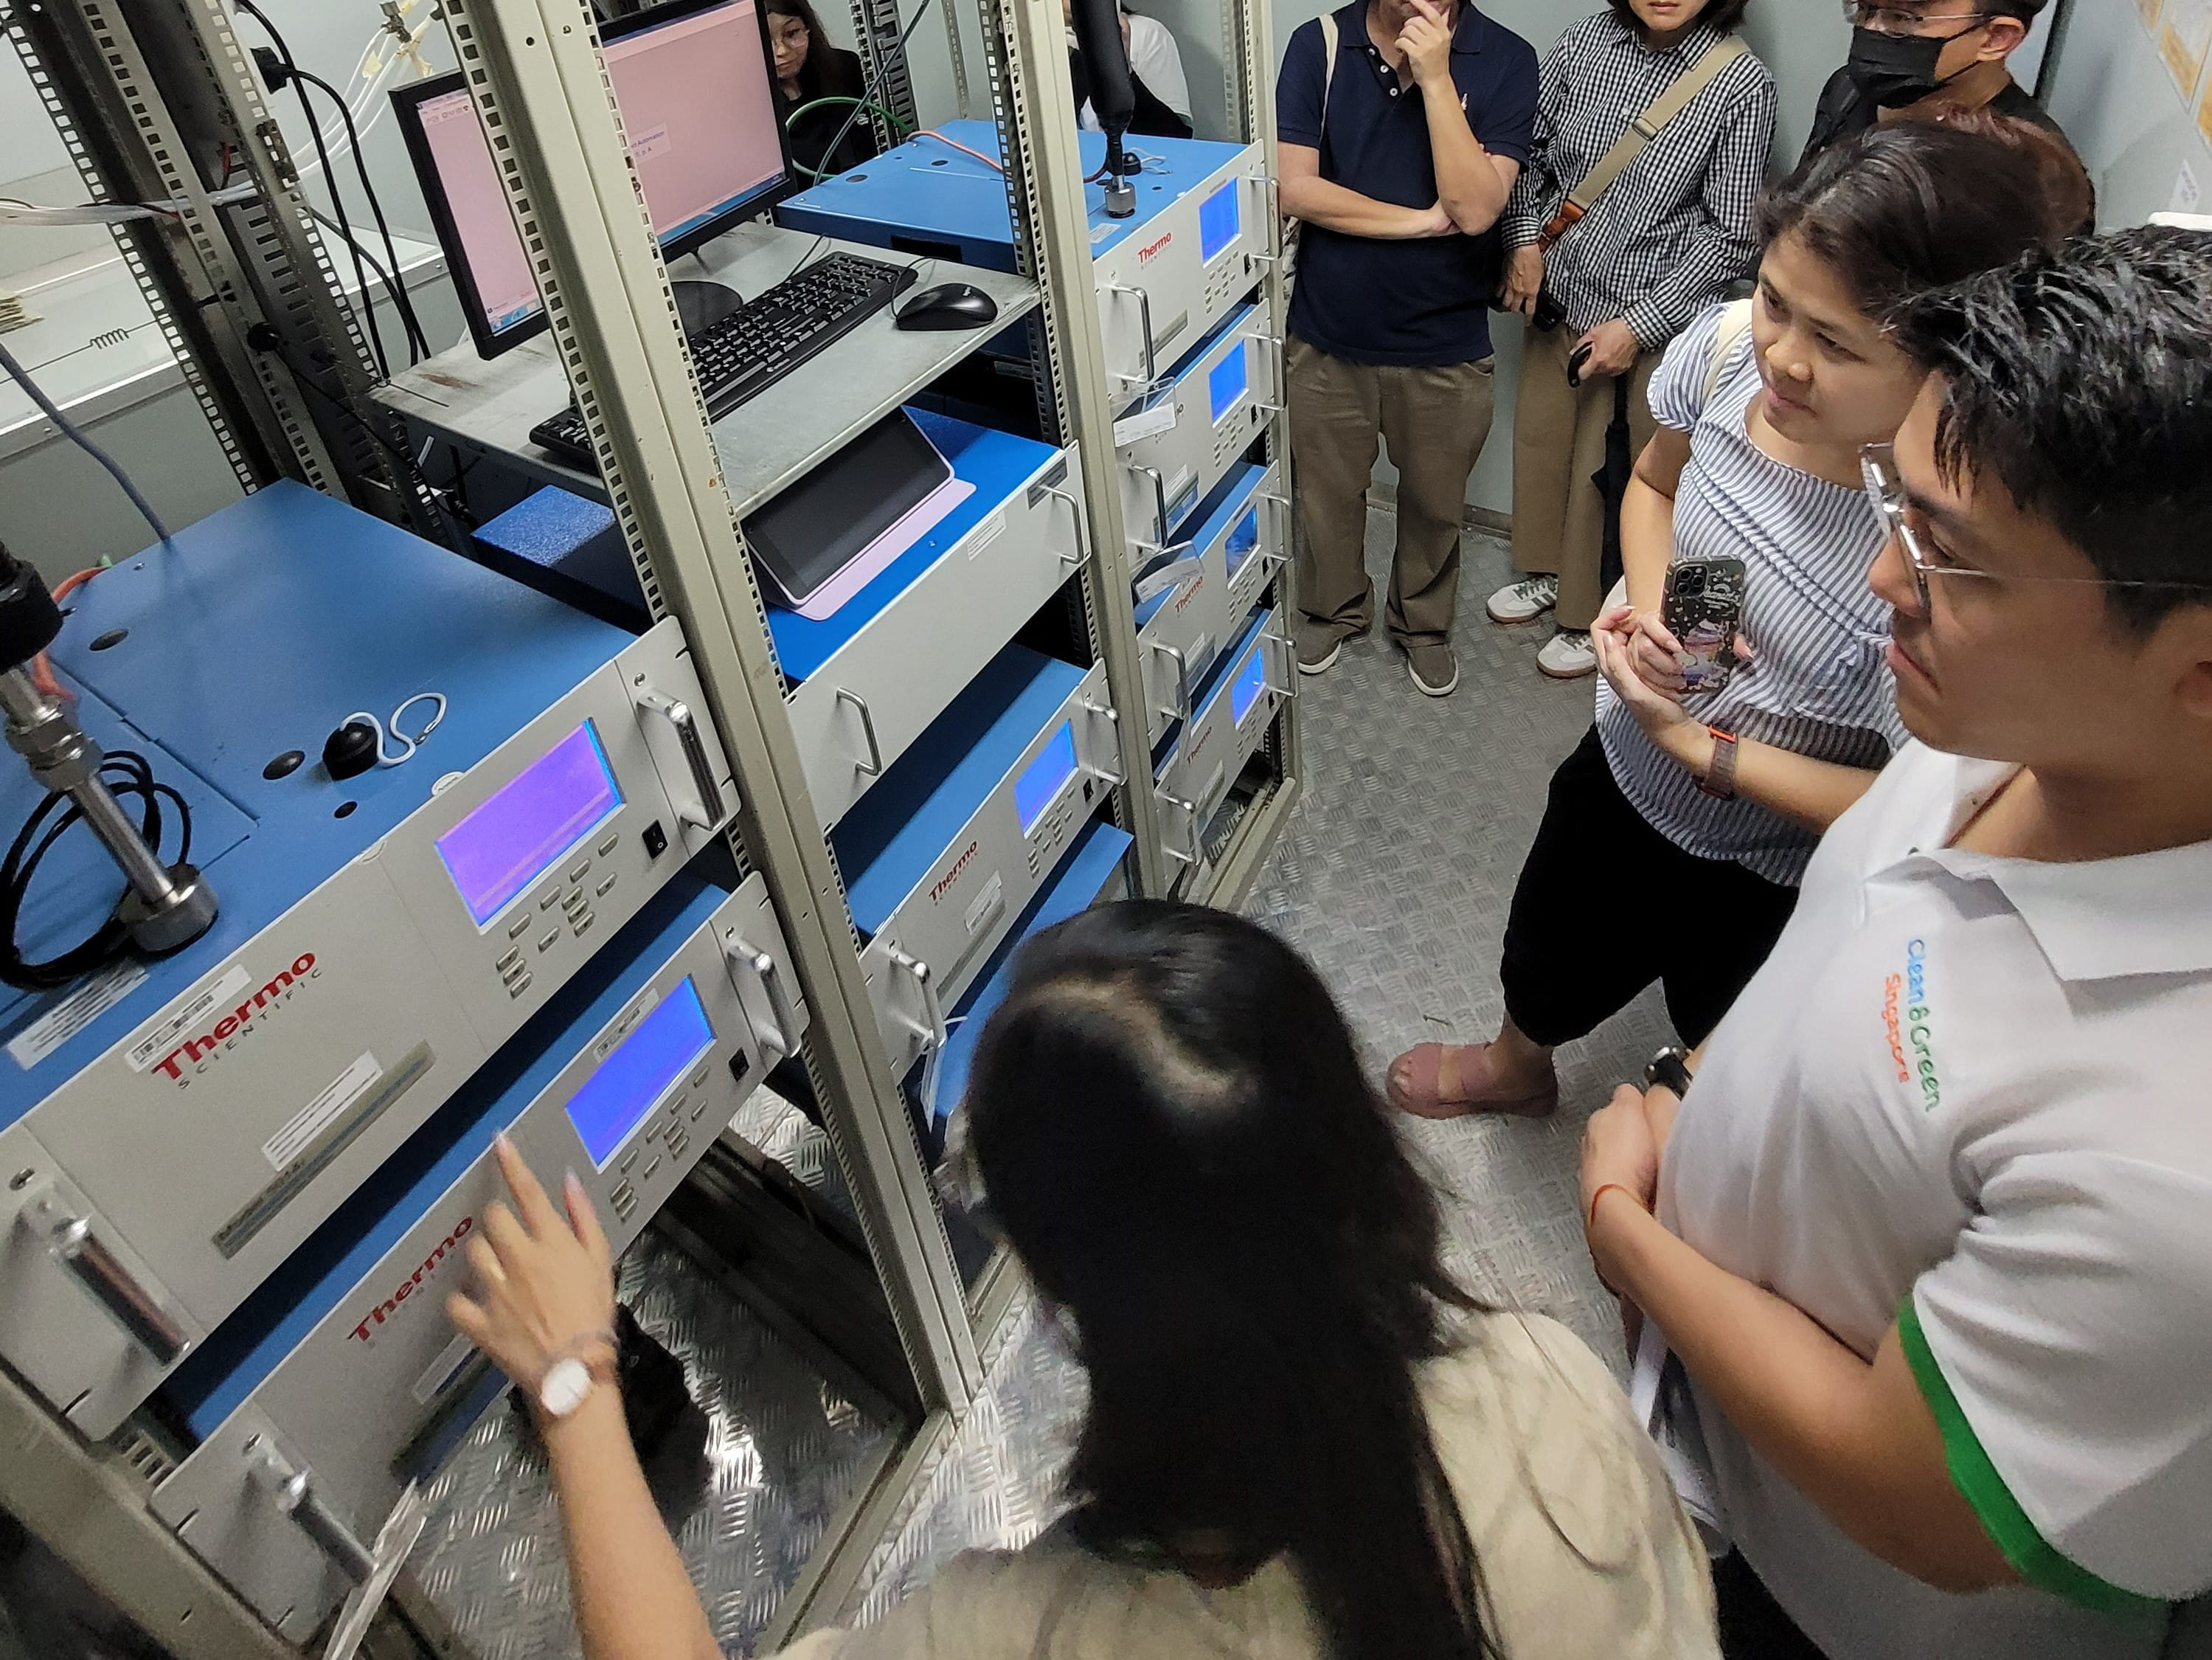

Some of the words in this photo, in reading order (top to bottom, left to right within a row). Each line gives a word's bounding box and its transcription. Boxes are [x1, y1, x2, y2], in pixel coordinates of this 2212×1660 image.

[1138, 232, 1172, 263] Thermo
[1175, 576, 1203, 613] Thermo
[929, 841, 978, 902] Thermo
[1908, 938, 1925, 1004] Clean
[151, 952, 316, 1080] Thermo
[178, 967, 322, 1090] SCIENTIFIC
[1911, 1026, 1941, 1113] Green
[347, 1216, 473, 1341] Thermo
